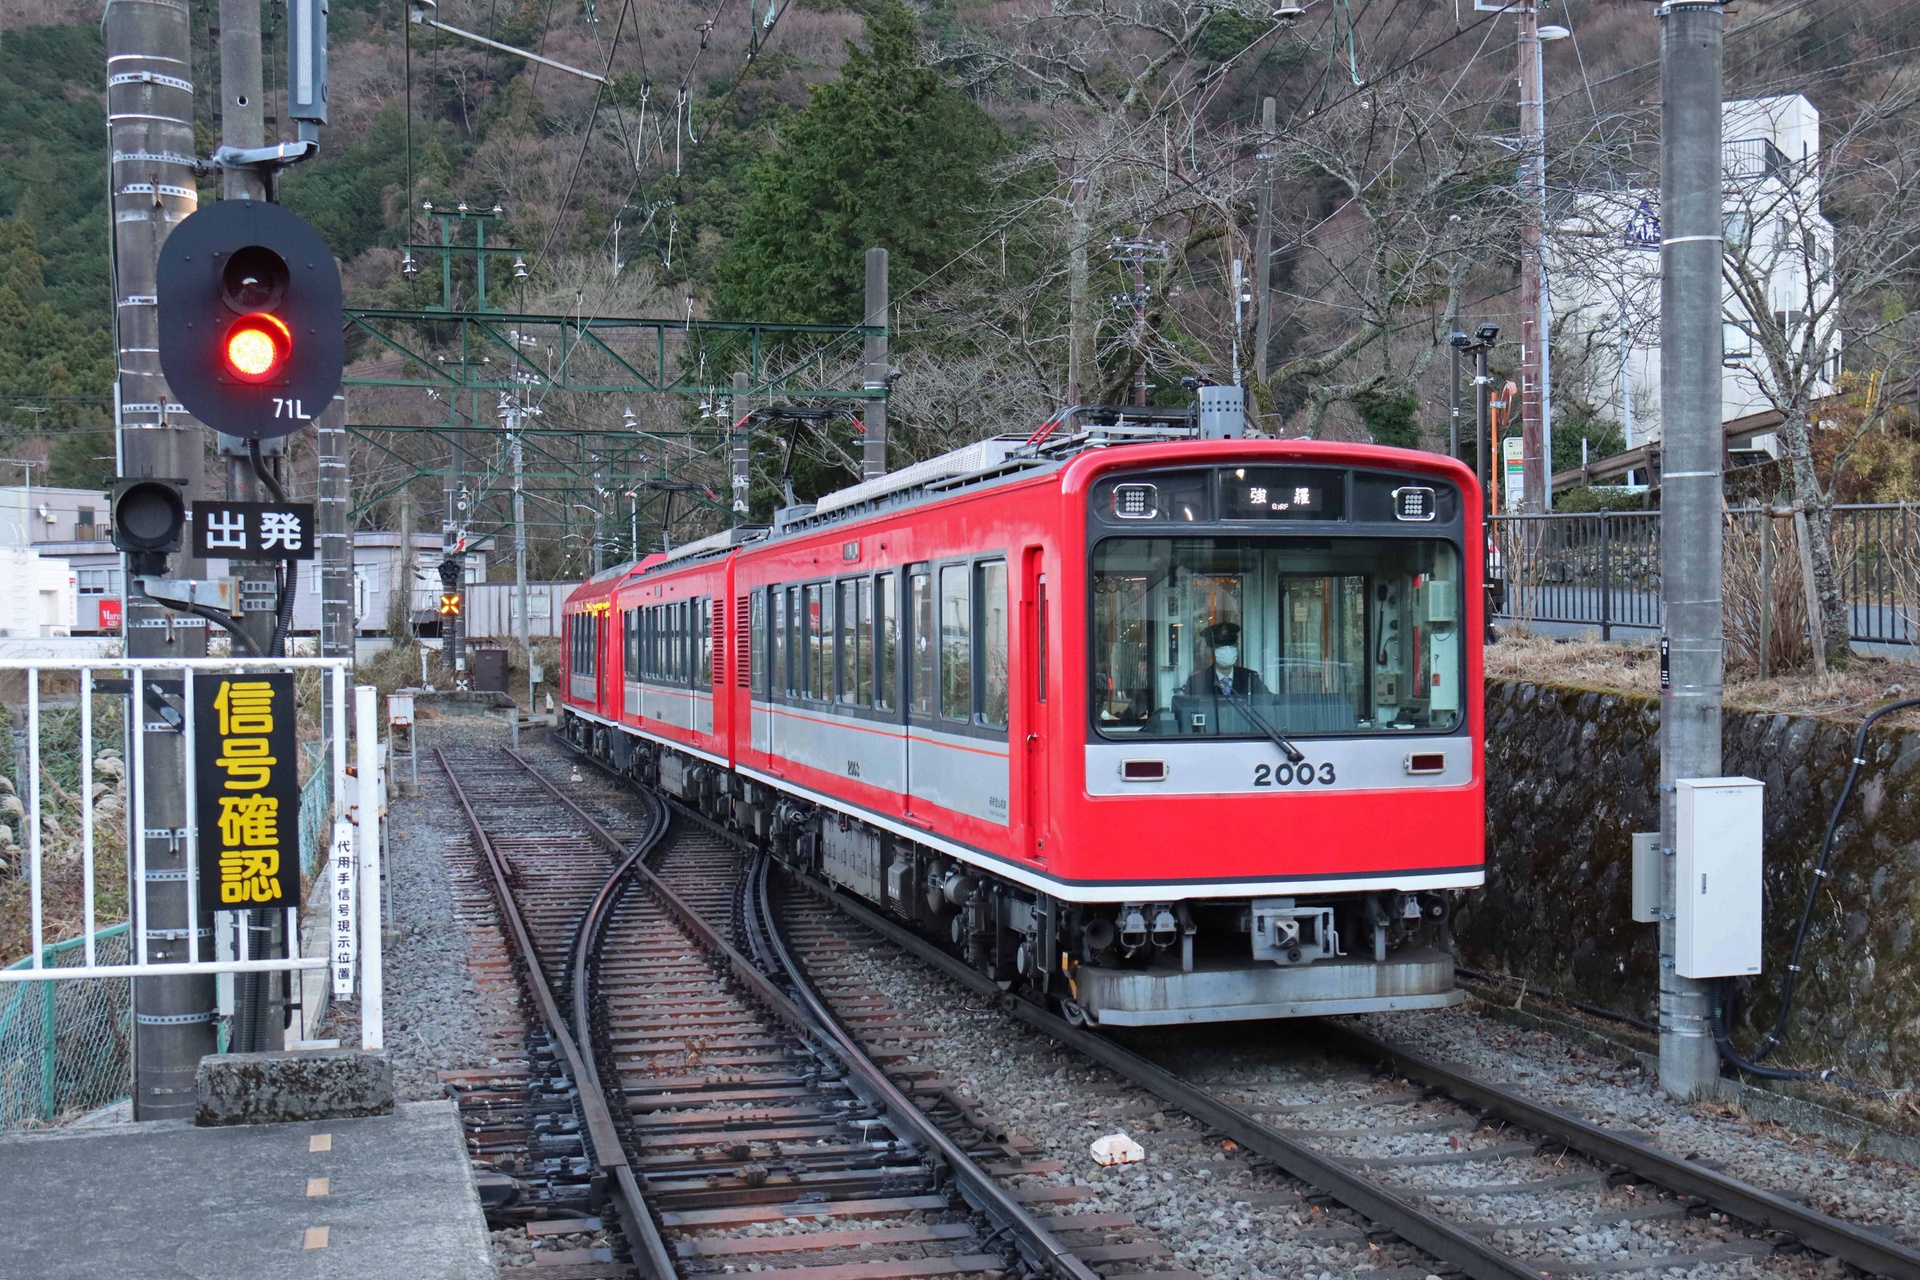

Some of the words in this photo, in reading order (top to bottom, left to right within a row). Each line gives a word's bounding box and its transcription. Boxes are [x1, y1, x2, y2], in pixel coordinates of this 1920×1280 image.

[272, 398, 311, 419] 71L
[206, 510, 302, 550] 出発
[213, 680, 282, 904] 信号確認
[1254, 762, 1336, 786] 2003
[337, 840, 350, 980] 代用手信号現示位置
